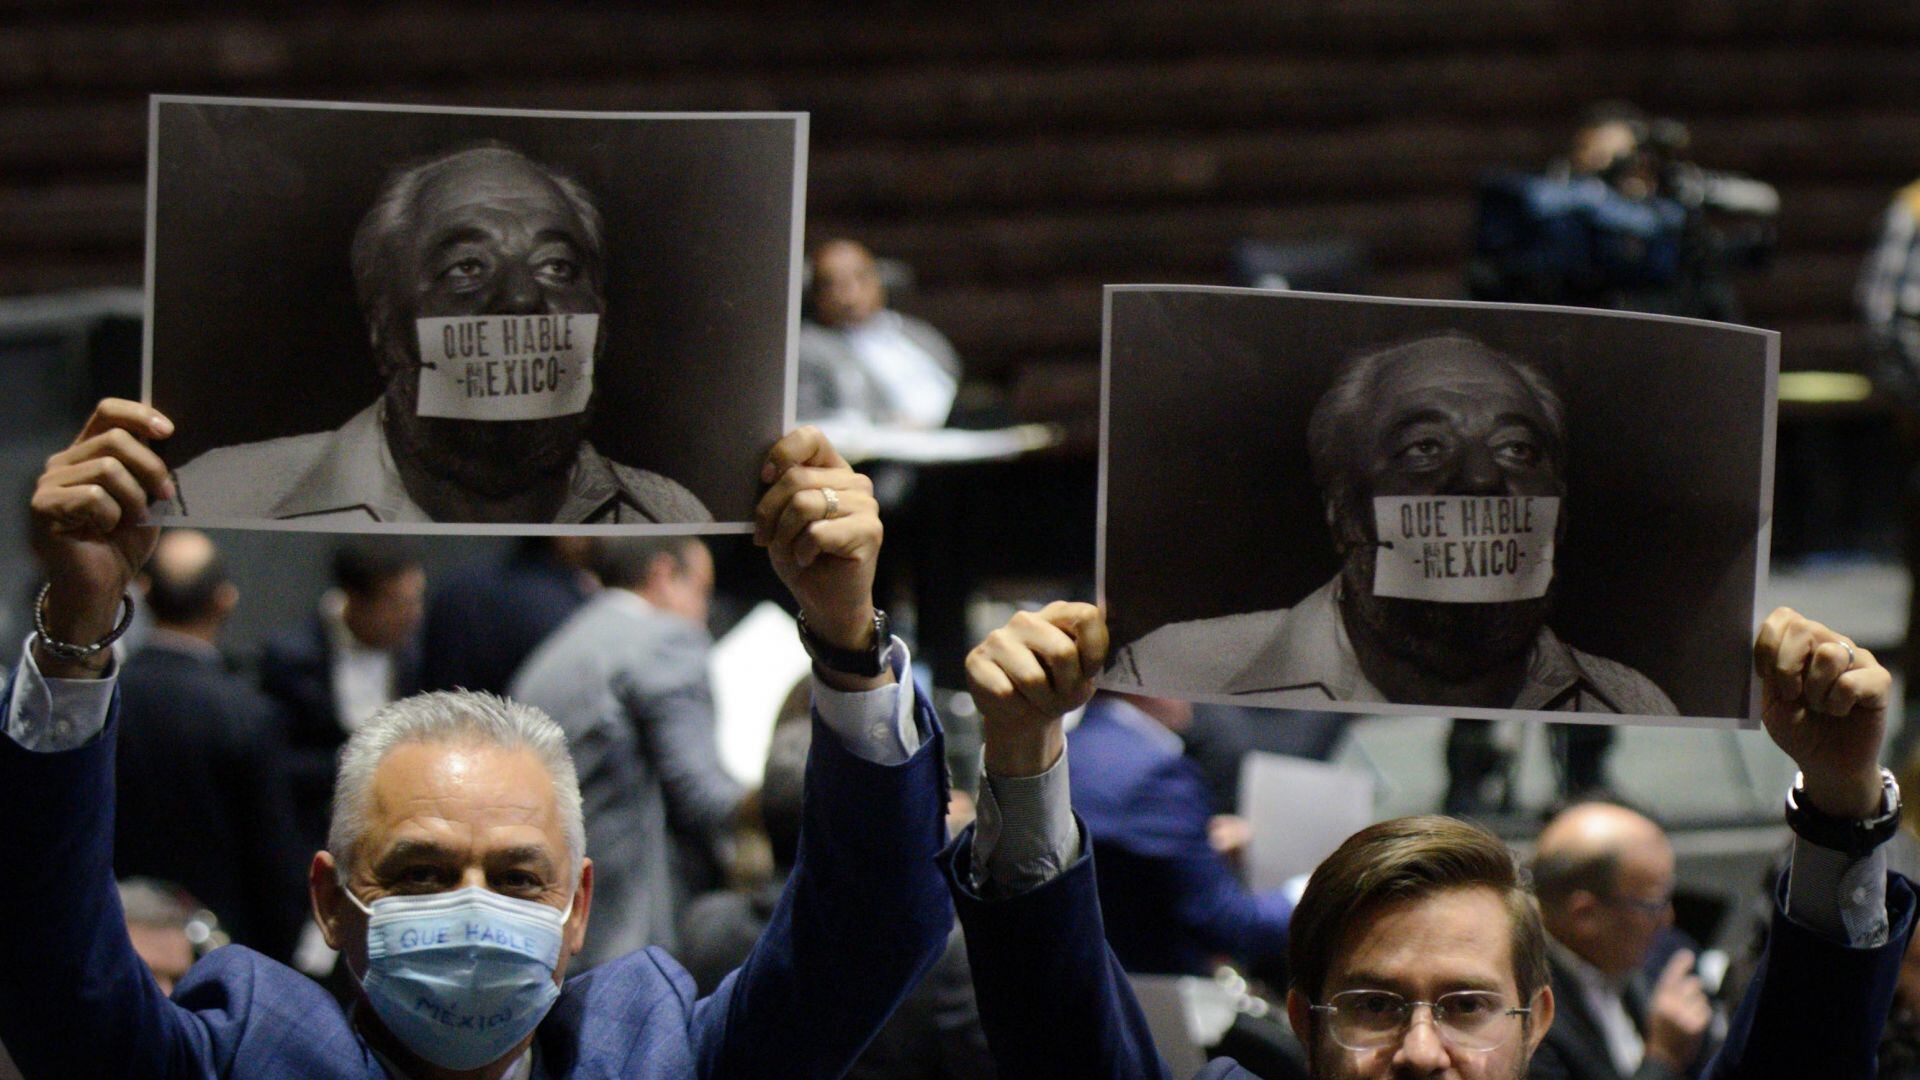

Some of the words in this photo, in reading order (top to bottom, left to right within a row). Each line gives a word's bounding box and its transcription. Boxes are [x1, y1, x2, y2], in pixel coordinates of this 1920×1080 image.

[443, 321, 489, 359] QUE
[503, 315, 574, 355] HABLE
[1401, 501, 1447, 539] QUE
[1461, 497, 1533, 537] HABLE
[401, 927, 450, 949] QUE
[465, 923, 536, 954] HABLE
